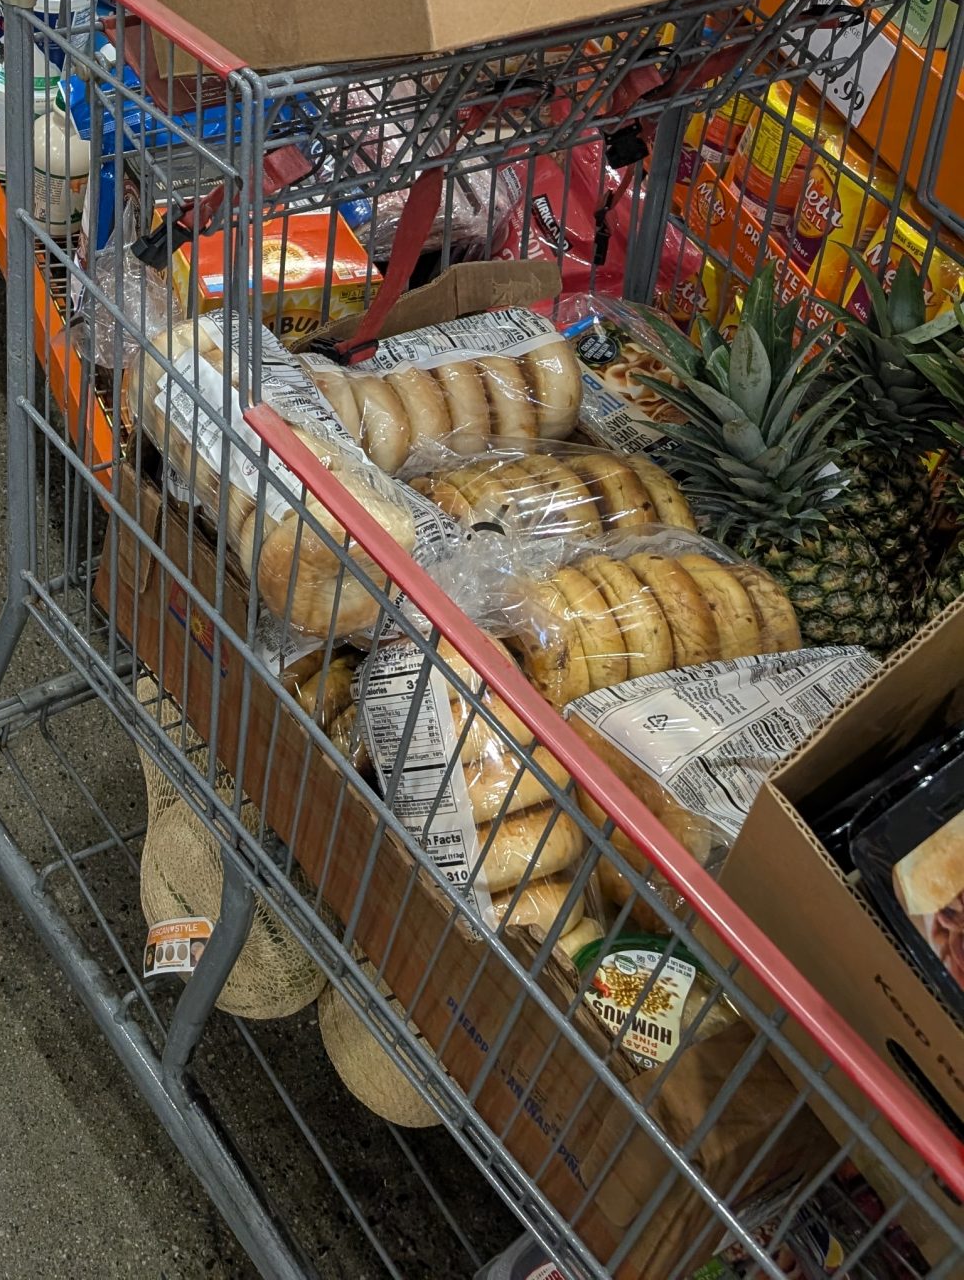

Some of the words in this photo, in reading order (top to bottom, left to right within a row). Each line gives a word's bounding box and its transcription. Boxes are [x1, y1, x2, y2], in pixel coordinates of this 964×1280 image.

[533, 195, 573, 255] KIRKLAND
[433, 832, 462, 846] Facts
[447, 869, 469, 883] 310
